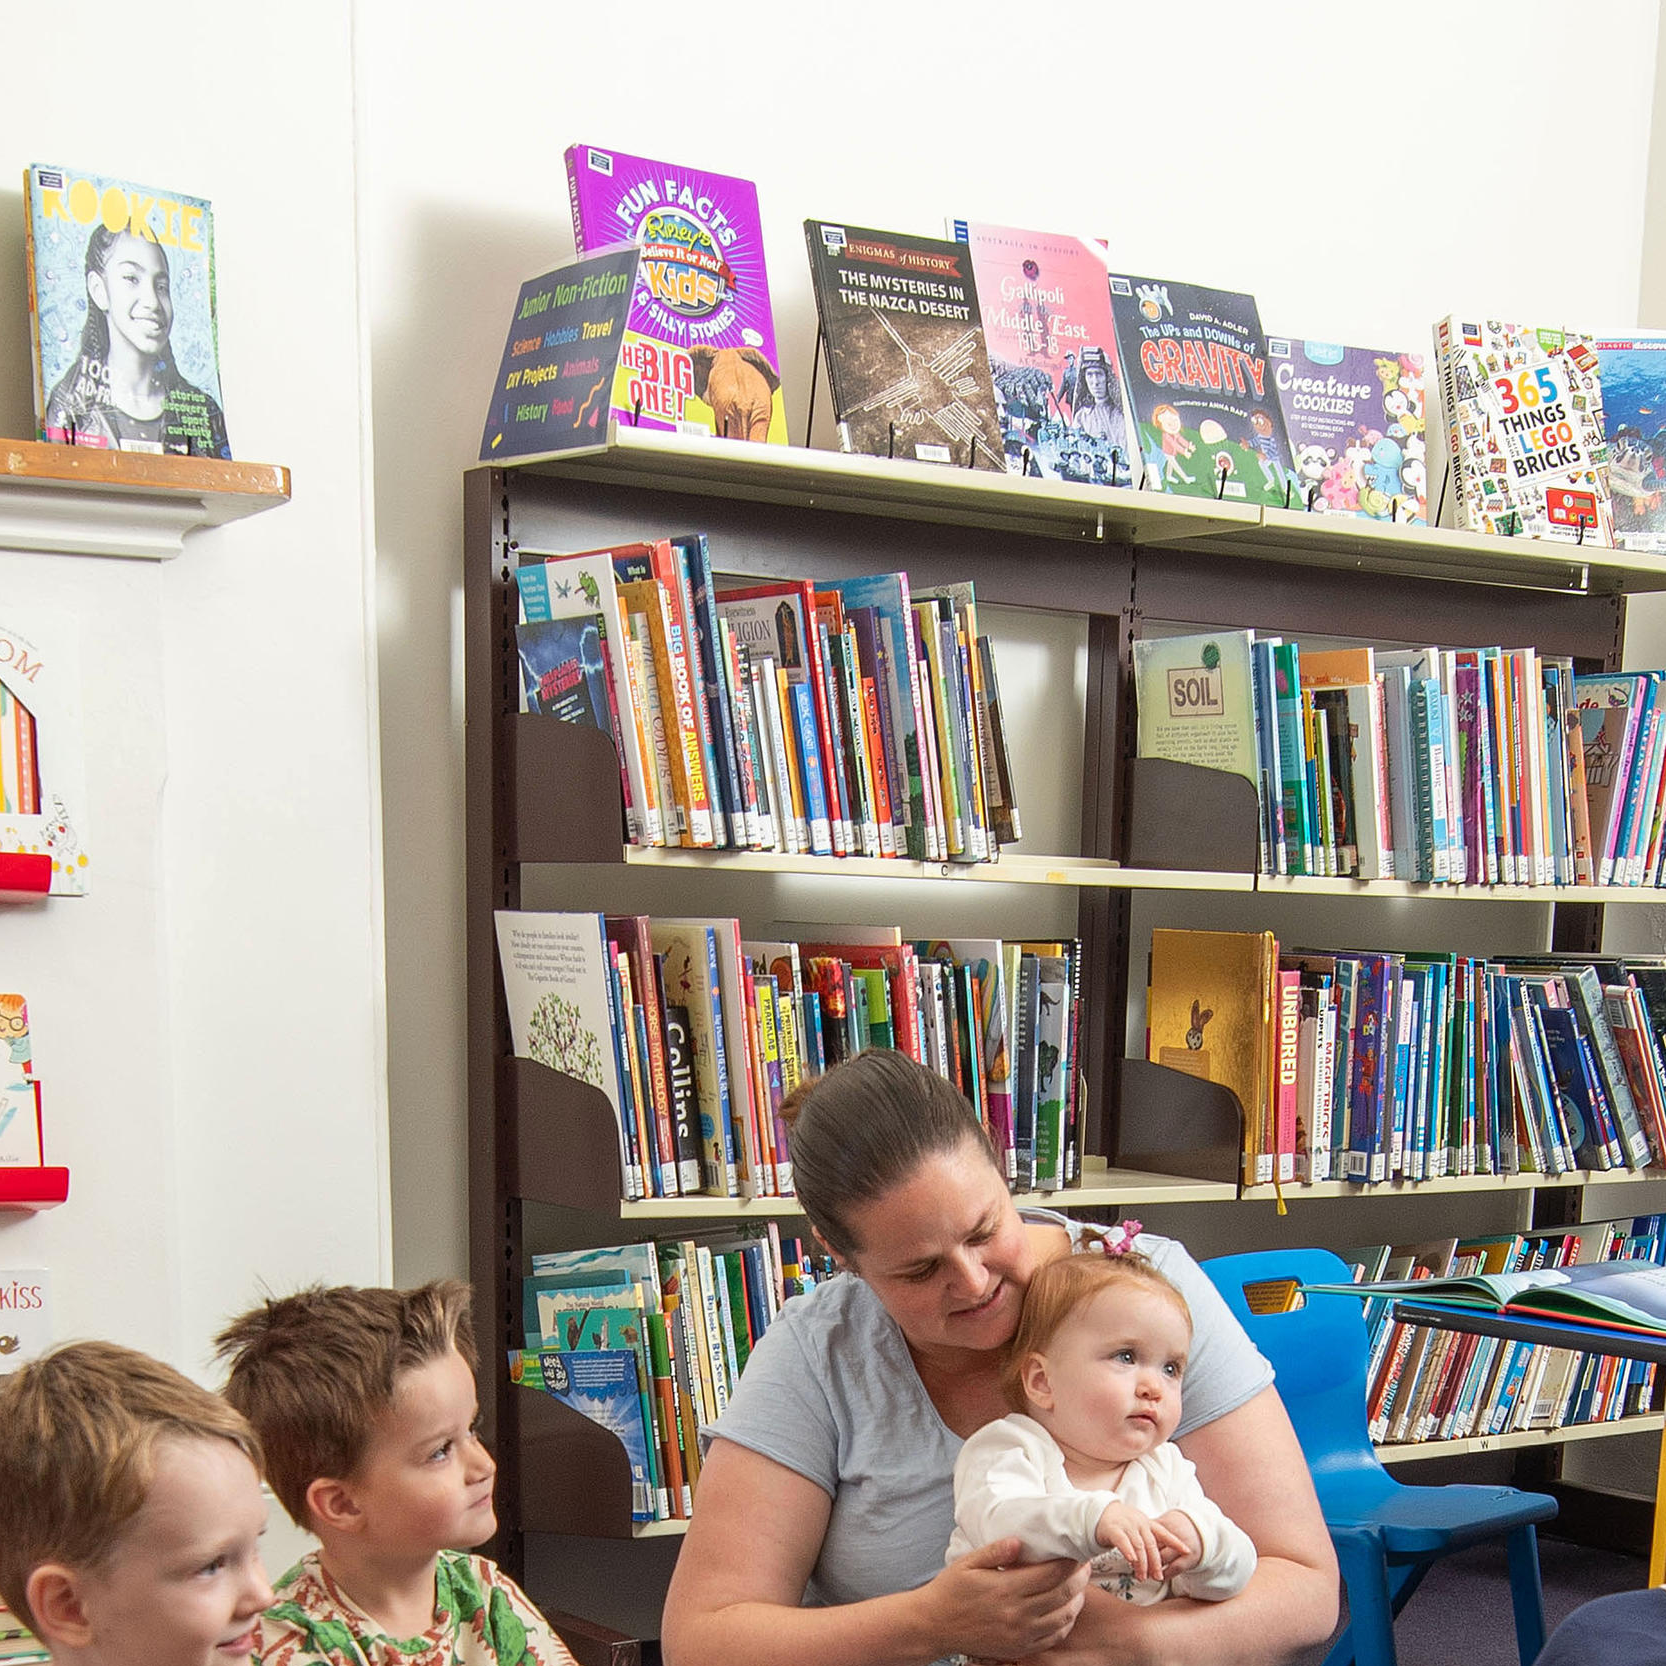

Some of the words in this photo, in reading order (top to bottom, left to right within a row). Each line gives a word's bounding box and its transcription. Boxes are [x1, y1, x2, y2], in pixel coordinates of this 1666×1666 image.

[42, 177, 203, 252] ROOKIE
[616, 180, 660, 226] FUN
[664, 180, 738, 246] FACTS
[641, 245, 674, 260] Believe
[675, 249, 685, 261] It
[687, 253, 698, 263] or
[699, 254, 721, 271] Not!
[849, 244, 895, 259] ENIGMAS
[899, 254, 908, 265] of
[908, 256, 951, 270] HISTORY
[977, 236, 1025, 249] AUSTRALIA
[1043, 246, 1079, 256] HISTORY
[518, 291, 552, 320] Junior
[553, 271, 628, 309] Non-Fiction
[646, 261, 717, 307] Kids
[838, 269, 868, 287] THE
[870, 274, 947, 298] MYSTERIES
[949, 286, 964, 301] IN
[1000, 276, 1064, 305] Gallipoli
[839, 289, 868, 306] THE
[869, 293, 917, 313] NAZCA
[919, 300, 970, 320] DESERT
[984, 305, 1044, 332] Middle
[511, 336, 542, 357] Science
[544, 326, 579, 347] Hobbies
[582, 318, 614, 340] Travel
[649, 306, 687, 336] SILLY
[689, 306, 736, 339] STORIES
[1189, 312, 1213, 322] DAVID
[1214, 318, 1221, 326] A.
[1223, 321, 1249, 336] ADLER
[1016, 331, 1059, 354] 1915-18
[1139, 326, 1160, 339] The
[1183, 327, 1202, 338] and
[1244, 342, 1256, 355] of
[506, 370, 521, 390] DIY
[522, 363, 558, 388] Projects
[562, 357, 600, 378] Animals
[622, 344, 643, 369] HE
[639, 342, 693, 397] BIG
[1140, 339, 1265, 396] GRAVITY
[1275, 363, 1371, 400] Creature
[171, 390, 206, 402] stories
[1293, 394, 1354, 415] COOKIES
[1494, 366, 1558, 414] 365
[168, 424, 212, 439] curiosity
[182, 414, 209, 428] sport
[1499, 403, 1567, 436] THINGS
[1518, 422, 1573, 454] LEGO
[1513, 444, 1581, 478] BRICKS
[900, 594, 913, 622] HOW
[668, 624, 685, 654] BIG
[901, 622, 921, 675] PEOPLE
[672, 656, 692, 707] BOOK
[908, 675, 923, 708] LIVED
[1174, 677, 1218, 707] SOIL
[681, 709, 694, 729] OF
[682, 731, 706, 802] ANSWERS
[1430, 747, 1444, 787] Baking
[1276, 984, 1301, 1085] UNBORED
[666, 1021, 691, 1140] Collins
[1321, 1041, 1334, 1089] MAGIC
[1319, 1091, 1332, 1138] TRICKS
